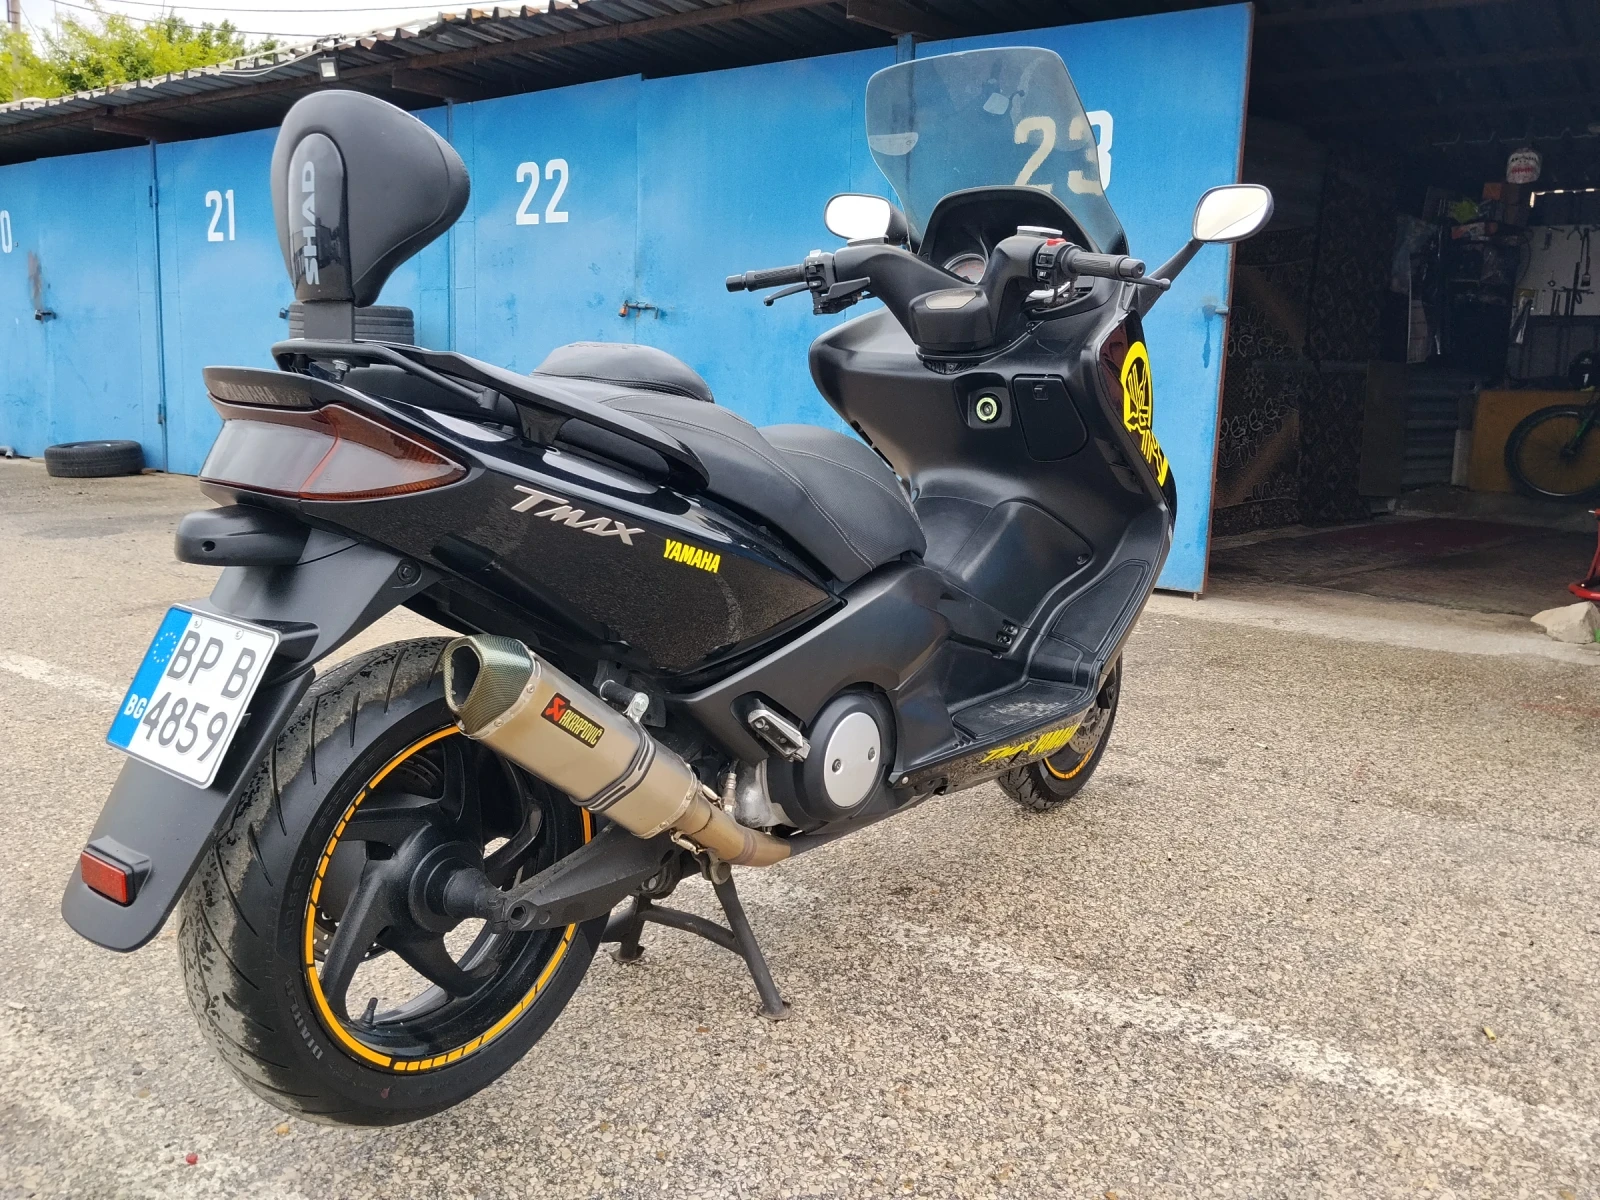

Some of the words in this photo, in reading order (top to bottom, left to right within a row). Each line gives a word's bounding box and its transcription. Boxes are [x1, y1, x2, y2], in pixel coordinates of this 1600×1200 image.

[1014, 110, 1114, 195] 23
[205, 189, 236, 242] 21
[302, 161, 320, 285] SHAD
[516, 158, 569, 225] 22
[663, 538, 721, 573] YAMAHA
[123, 693, 148, 720] BG
[142, 691, 229, 762] 4859
